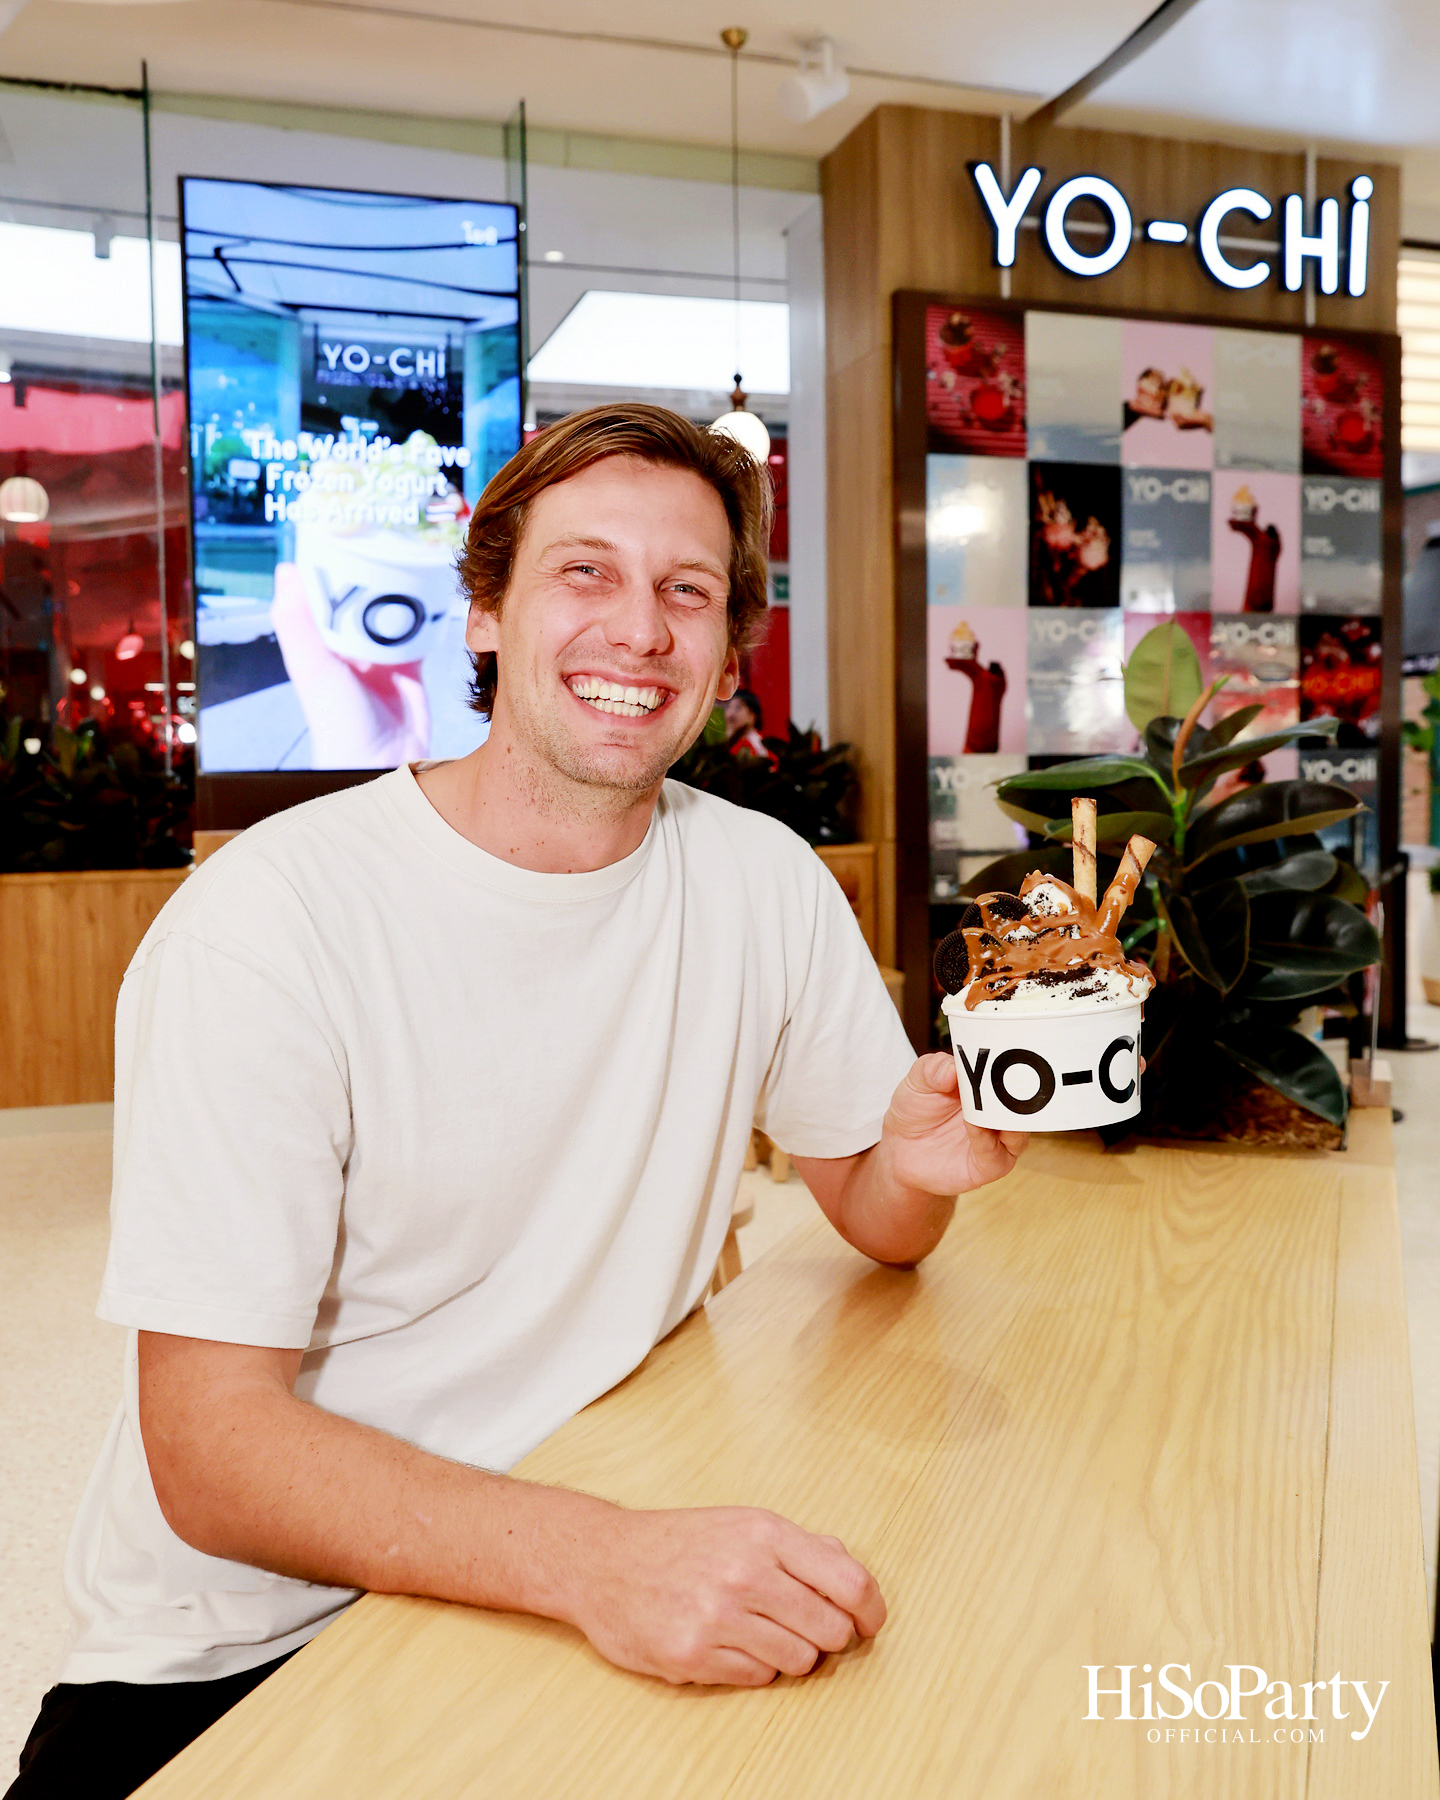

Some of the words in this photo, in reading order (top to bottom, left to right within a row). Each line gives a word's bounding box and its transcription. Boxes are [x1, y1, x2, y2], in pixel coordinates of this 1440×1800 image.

[248, 432, 297, 460] The
[307, 435, 403, 464] World's
[411, 438, 470, 467] Fave
[267, 463, 355, 492] Frozen
[360, 466, 447, 501] Yogurt
[957, 1030, 1141, 1115] YO-C
